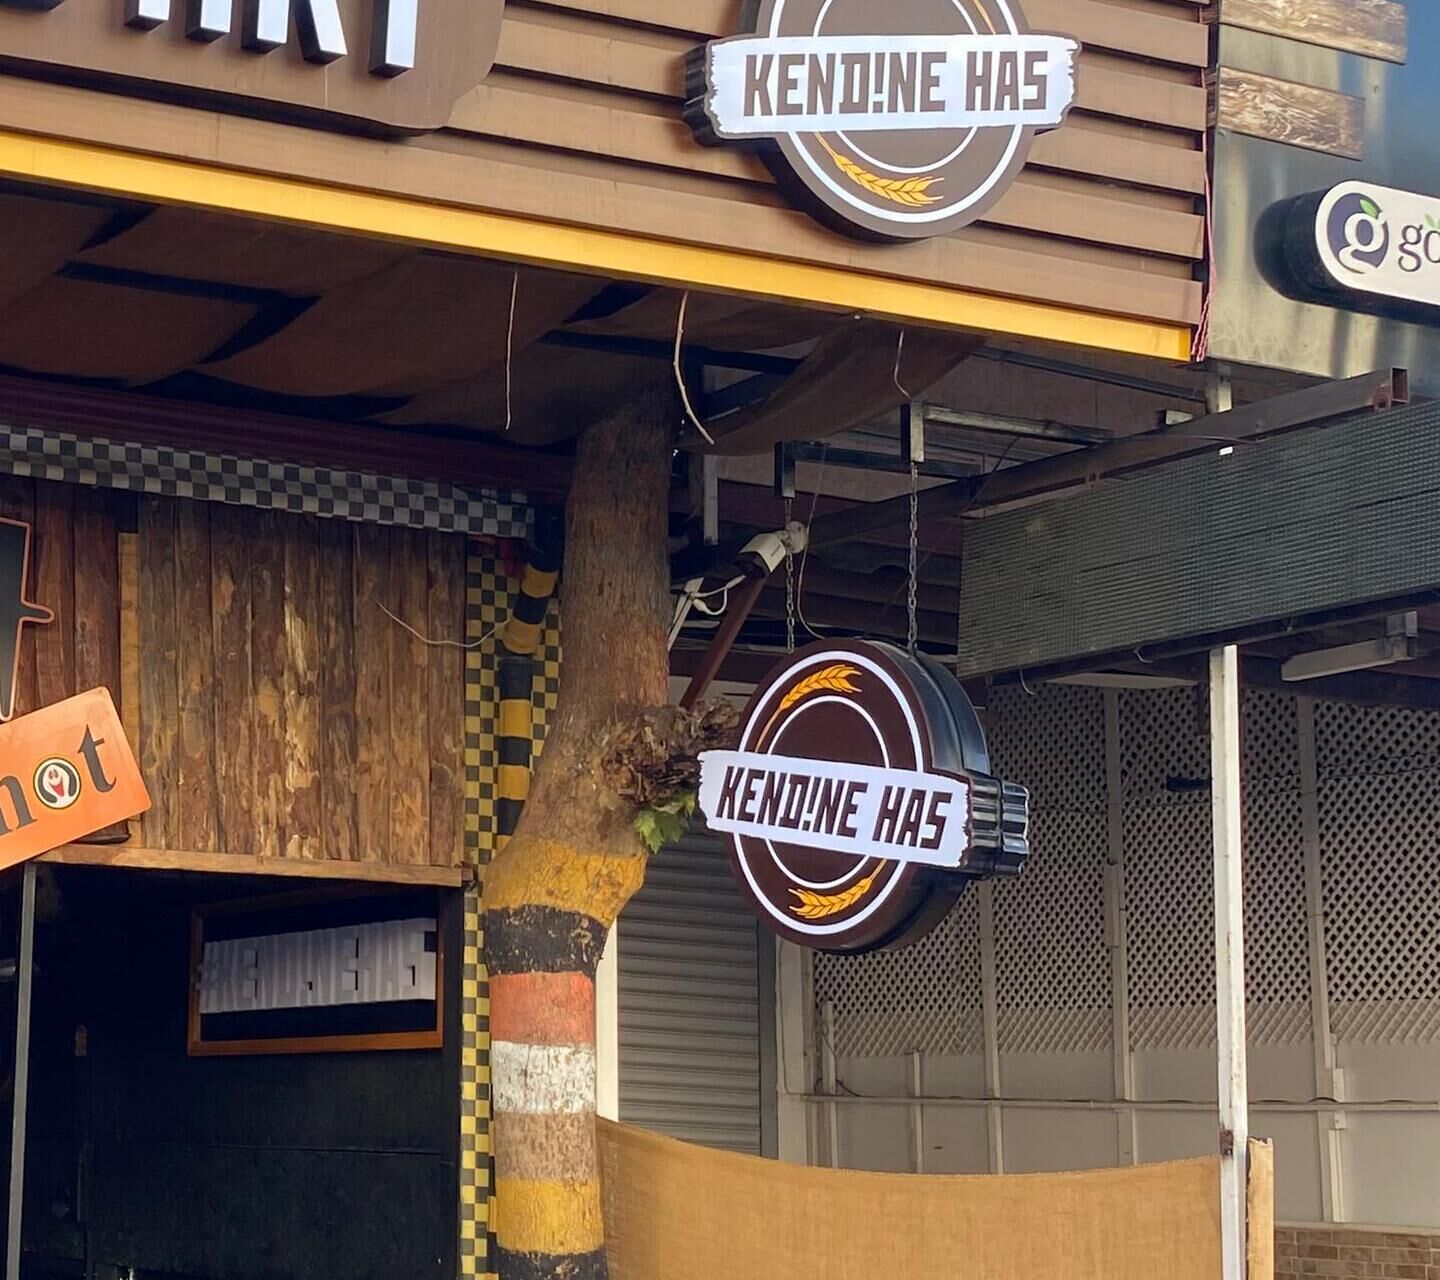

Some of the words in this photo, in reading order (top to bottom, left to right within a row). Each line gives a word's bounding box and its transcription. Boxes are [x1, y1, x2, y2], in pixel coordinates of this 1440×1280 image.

[743, 50, 948, 117] KEND!NE
[964, 50, 1049, 112] HAS
[715, 765, 869, 839] KEND!NE
[871, 785, 953, 851] HAS
